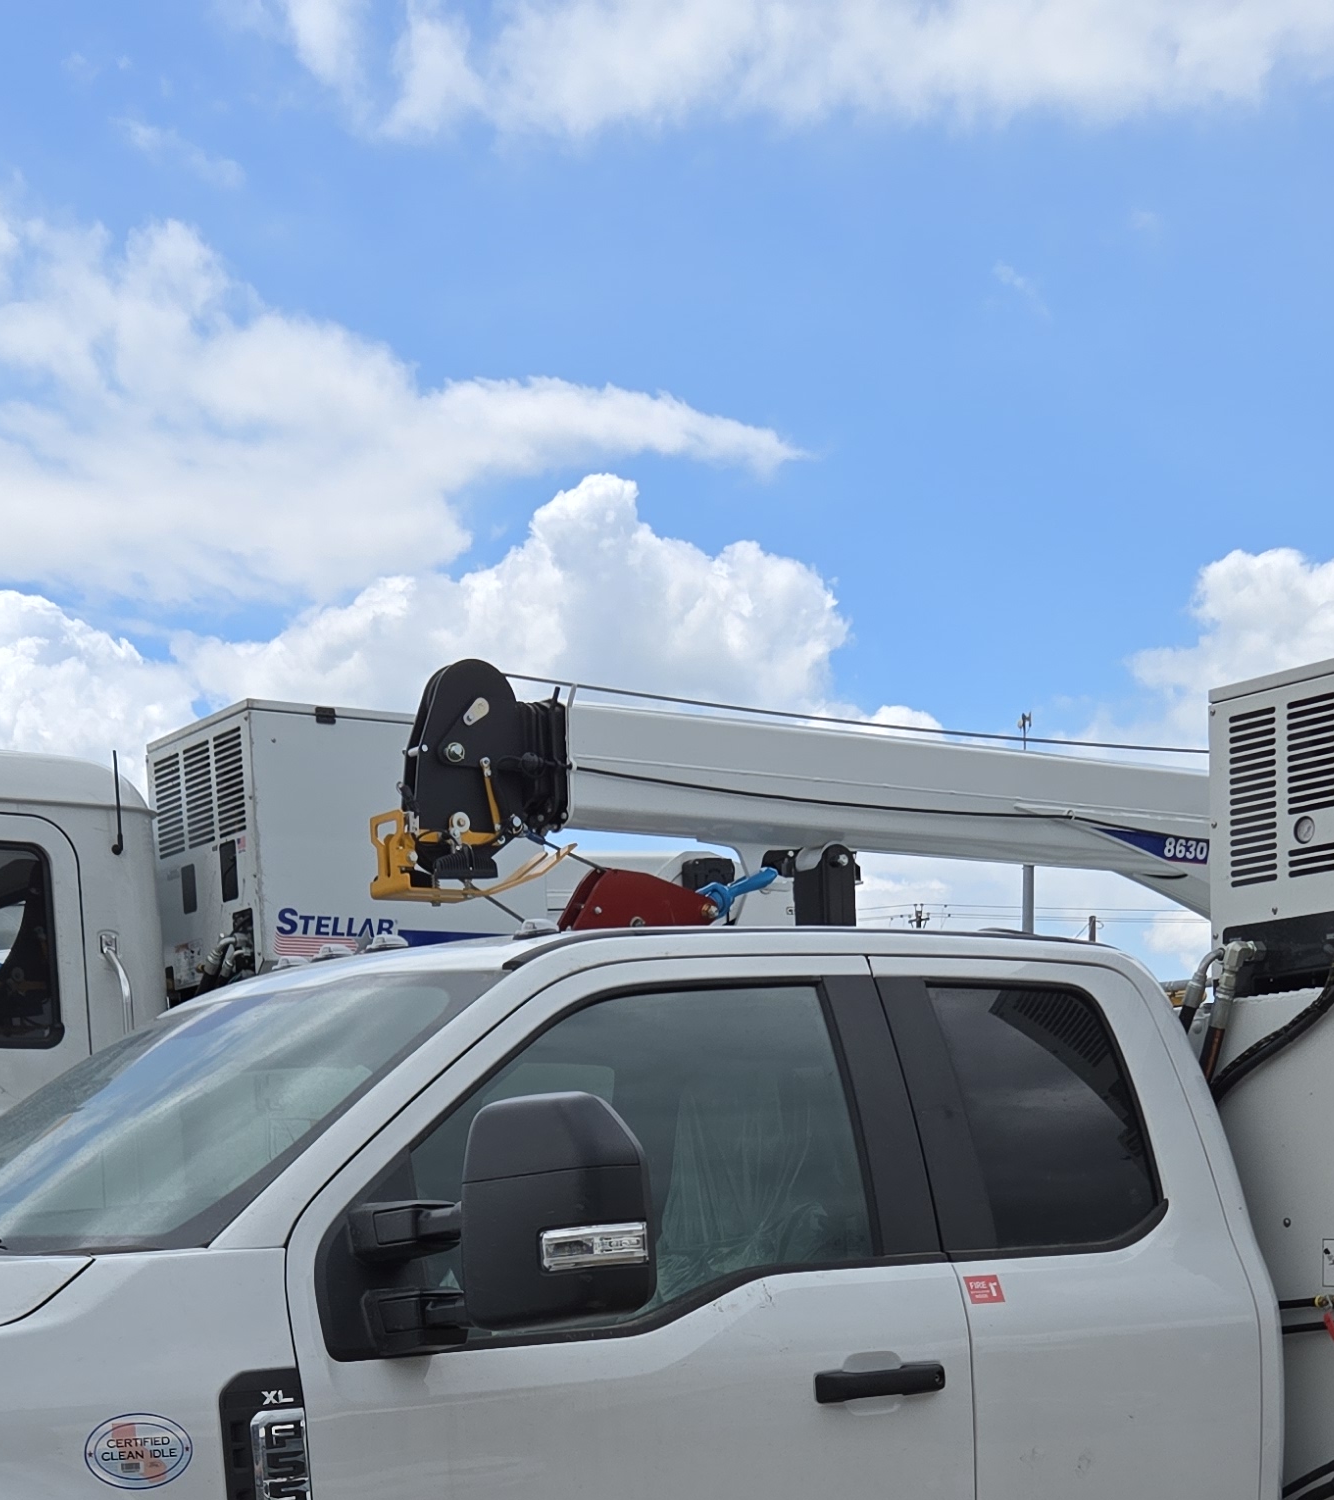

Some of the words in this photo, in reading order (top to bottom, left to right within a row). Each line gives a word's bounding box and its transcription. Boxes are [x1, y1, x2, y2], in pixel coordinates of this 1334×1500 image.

[1163, 837, 1208, 860] 8630
[276, 907, 395, 938] STELLAR
[261, 1390, 294, 1405] XL
[106, 1436, 170, 1449] CERTIFIED
[101, 1449, 145, 1462] CLEAN
[149, 1448, 178, 1459] IDLE
